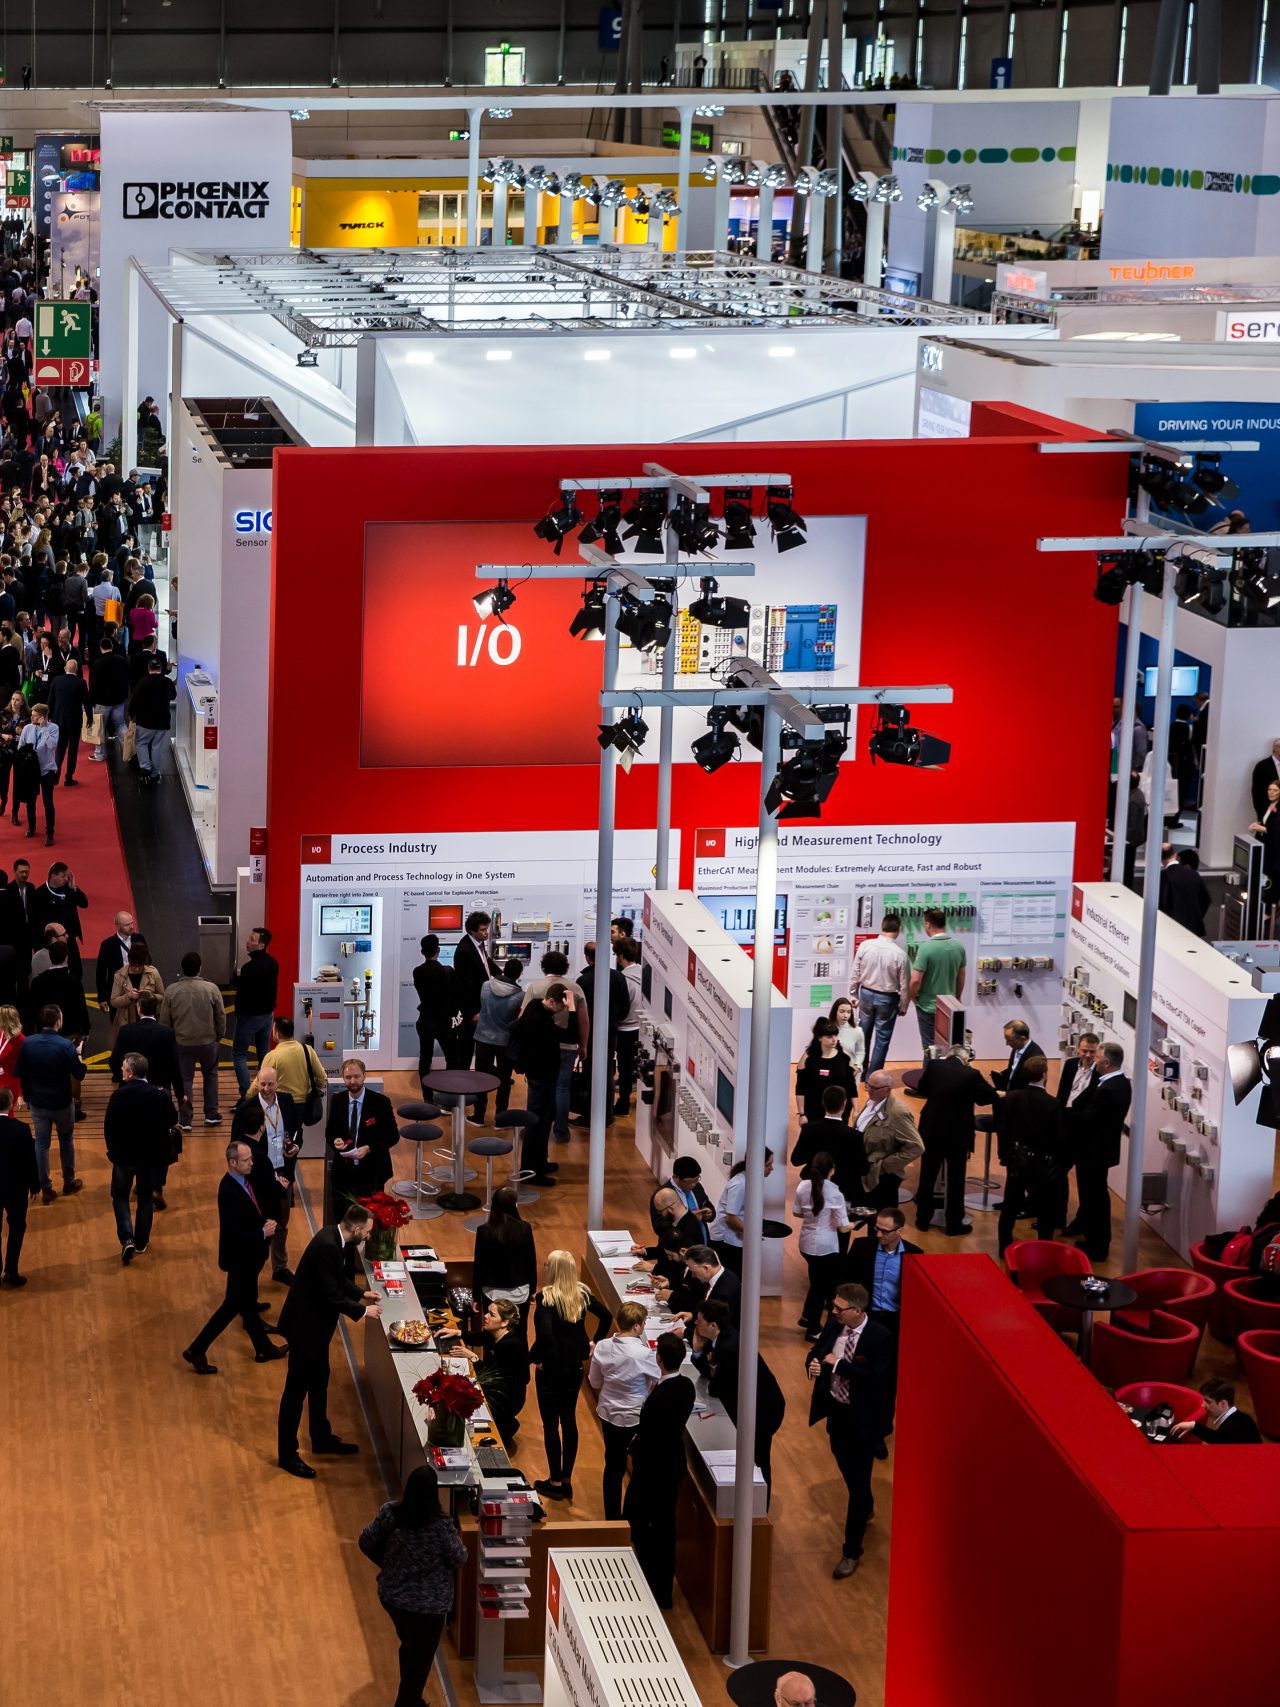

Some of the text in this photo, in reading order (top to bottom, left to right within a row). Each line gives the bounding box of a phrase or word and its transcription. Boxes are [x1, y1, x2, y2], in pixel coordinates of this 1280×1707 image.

[159, 200, 269, 220] CONTACT
[339, 221, 385, 230] TURCK
[1231, 322, 1280, 339] ser
[1158, 419, 1208, 431] DRIVING
[1211, 419, 1244, 430] YOUR
[235, 538, 268, 547] Sensor
[457, 624, 522, 667] I/O
[735, 833, 942, 850] Highnd Measurement Technology
[311, 846, 322, 854] I/O
[340, 842, 438, 855] Process Industry
[698, 866, 735, 875] EtherCAT
[795, 865, 833, 874] Modules:
[834, 865, 875, 874] Extremely
[877, 864, 915, 872] Accurate,
[917, 863, 933, 872] Fast
[936, 863, 951, 871] and
[953, 862, 982, 871] Robust
[306, 871, 516, 883] Automation and Process Technology in One System
[1086, 903, 1130, 946] Industrial Ethernet
